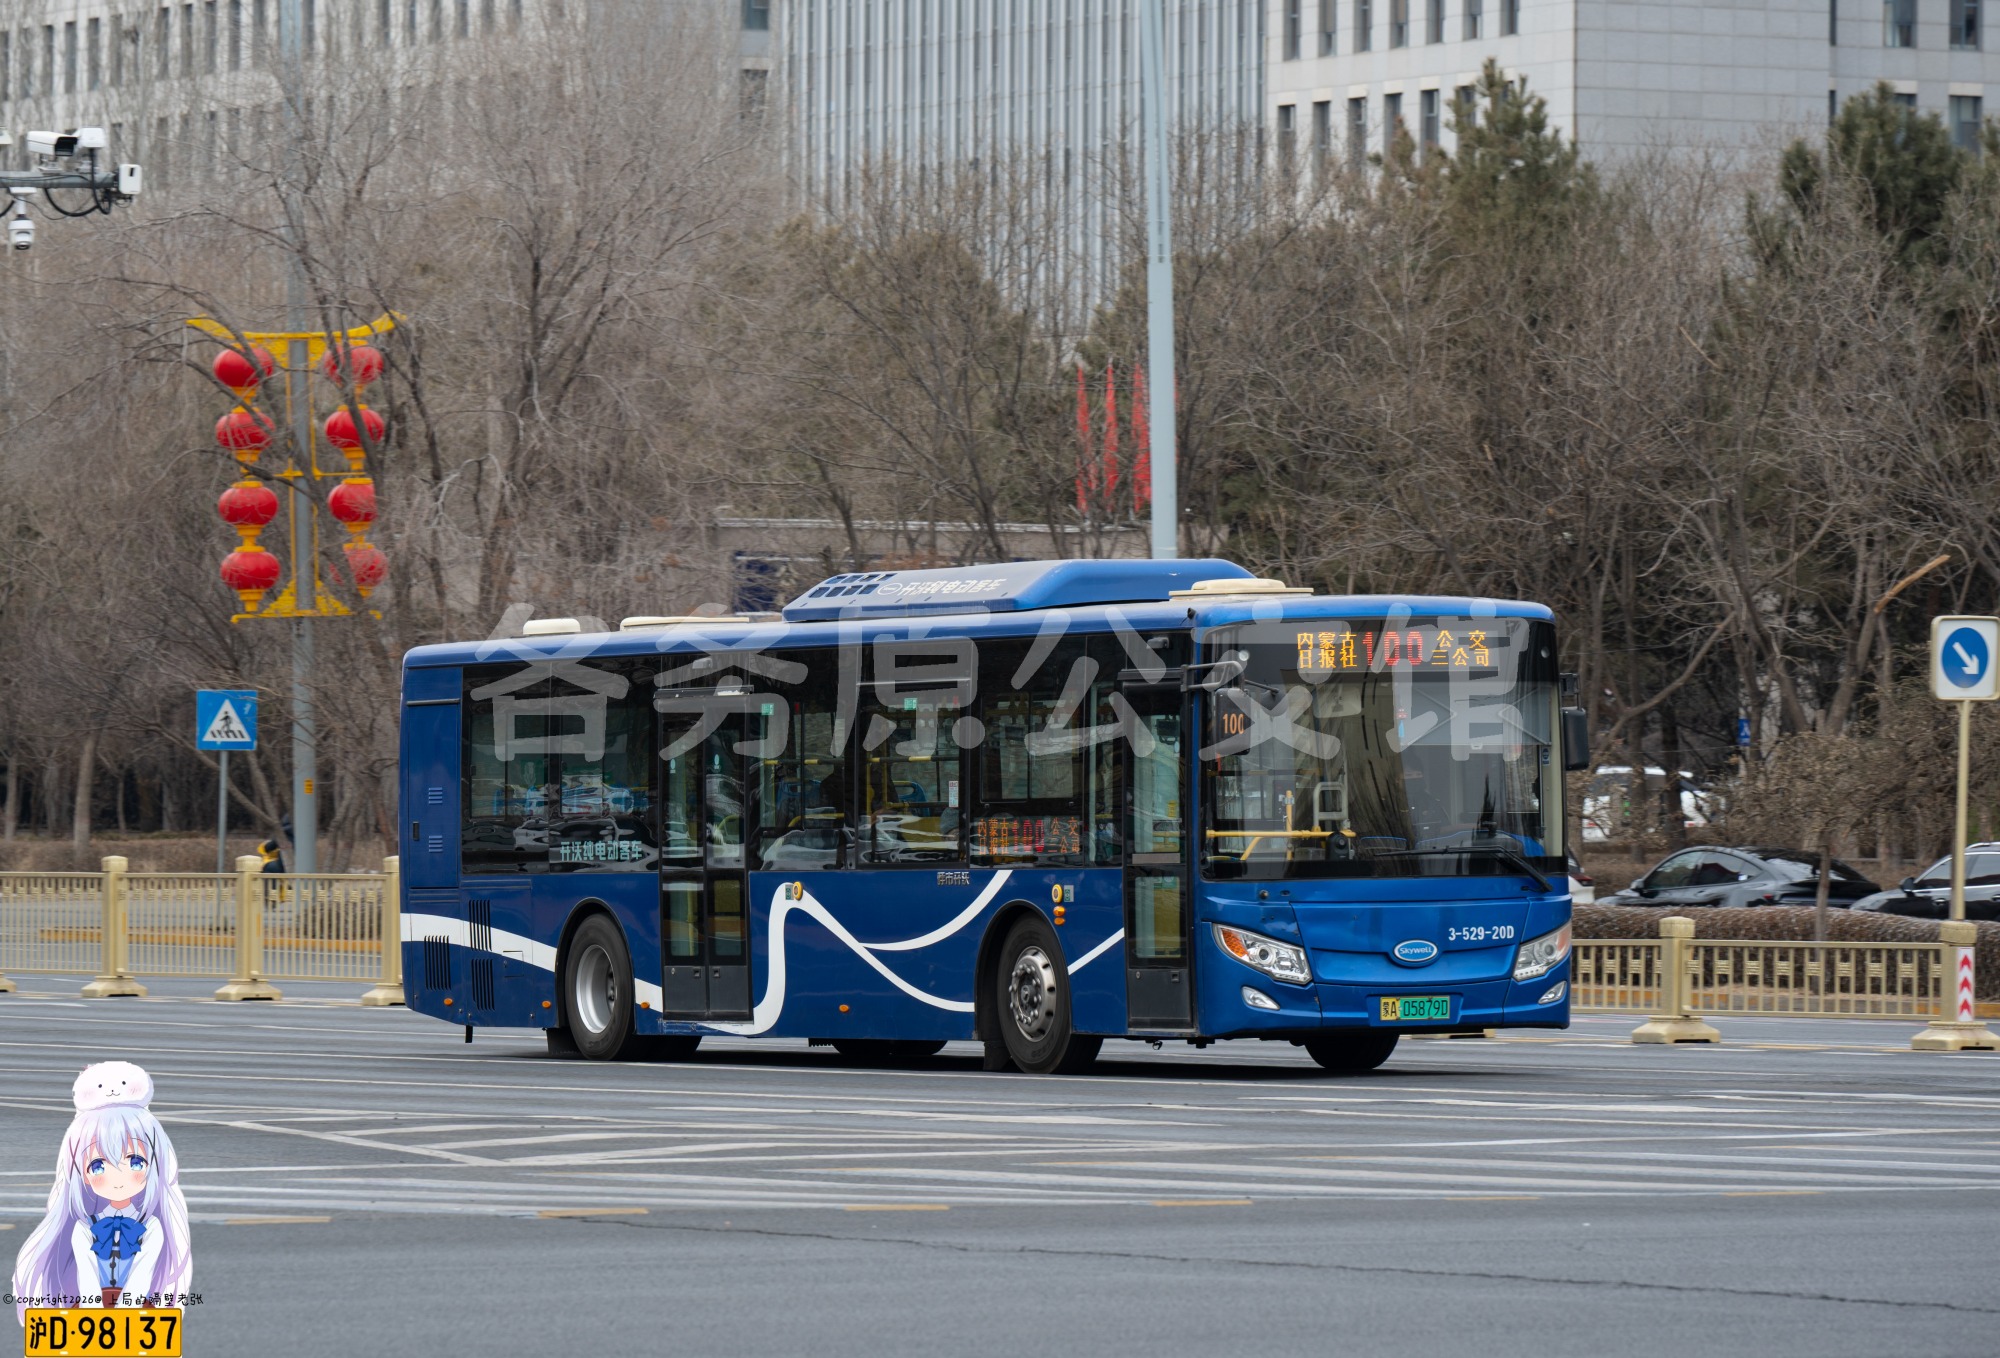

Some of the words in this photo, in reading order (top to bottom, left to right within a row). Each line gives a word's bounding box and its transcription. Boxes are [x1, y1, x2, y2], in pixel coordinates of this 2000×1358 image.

[1296, 631, 1358, 650] 内蒙古
[1362, 631, 1423, 666] 100
[1436, 630, 1487, 649] 公交
[1298, 649, 1358, 669] 日报社
[1431, 649, 1489, 667] 三公司
[1222, 713, 1245, 735] 100
[977, 818, 1009, 837] 内蒙古
[1012, 819, 1045, 853] 100
[559, 840, 643, 861] 开沃纯电动客车
[1448, 925, 1515, 941] 3-529-20D
